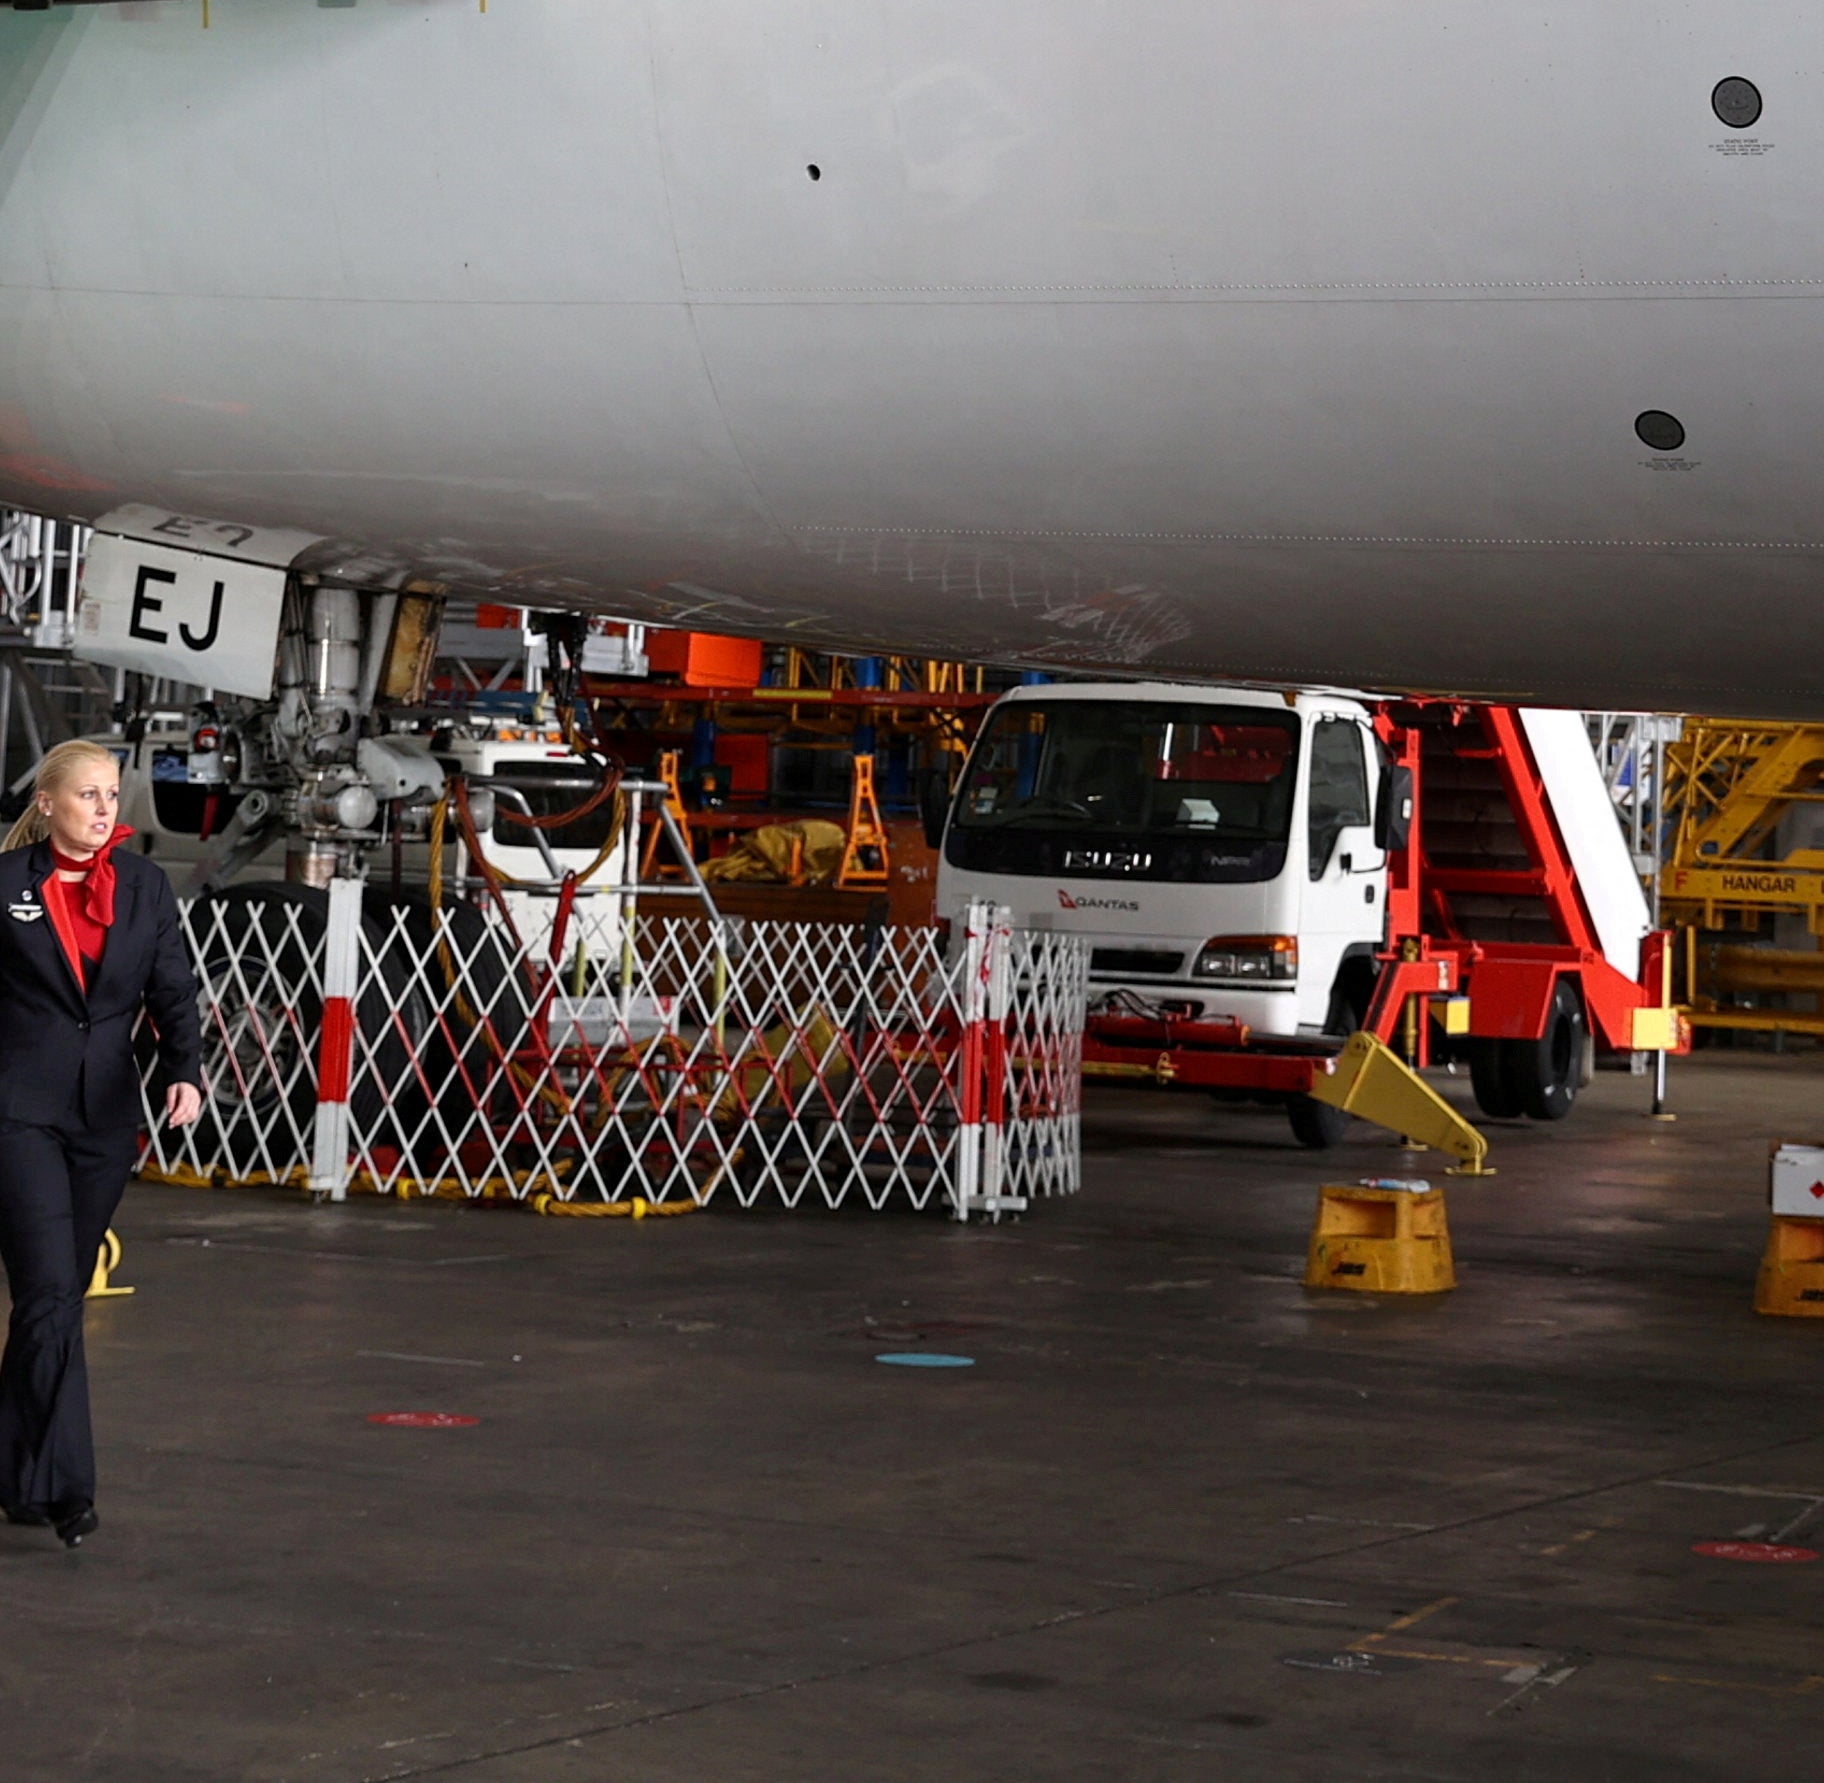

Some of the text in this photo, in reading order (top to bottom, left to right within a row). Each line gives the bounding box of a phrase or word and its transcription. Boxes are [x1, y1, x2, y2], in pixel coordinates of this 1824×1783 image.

[128, 564, 225, 652] EJ
[1064, 850, 1153, 873] ISUZU
[1722, 875, 1796, 894] HANGAR
[1075, 895, 1140, 912] QANTAS
